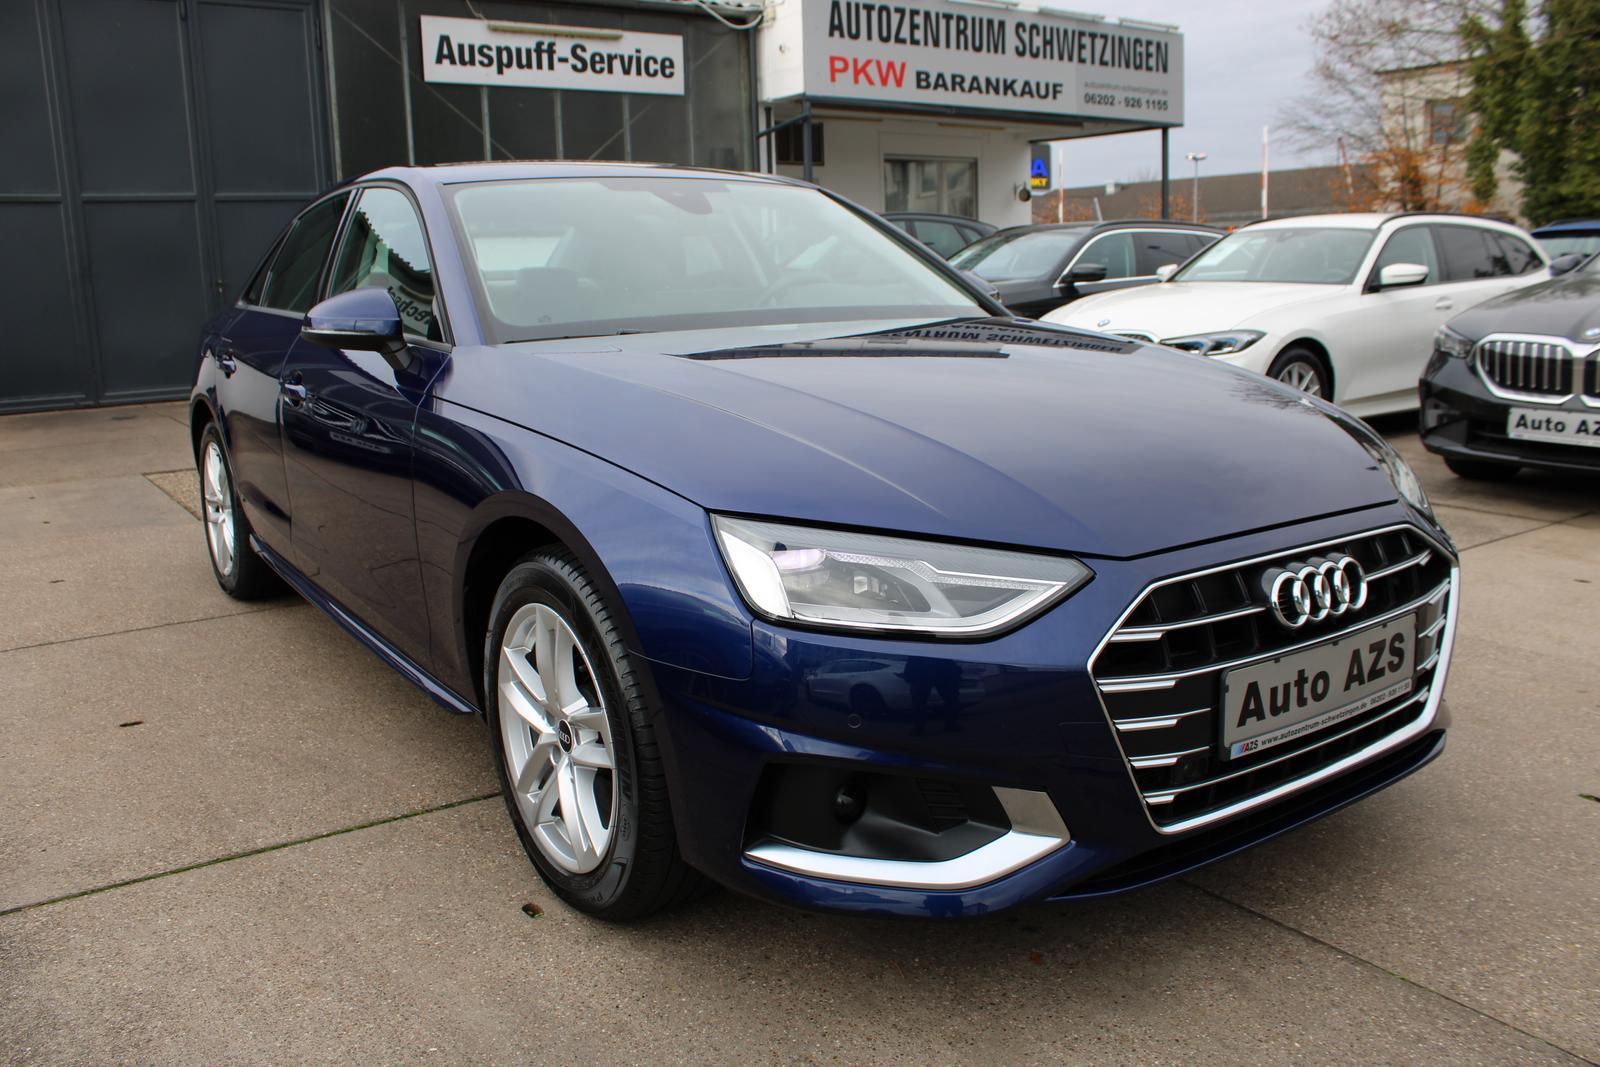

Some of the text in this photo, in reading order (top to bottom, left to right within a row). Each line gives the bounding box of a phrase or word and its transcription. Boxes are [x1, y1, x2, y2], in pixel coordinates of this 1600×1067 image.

[435, 34, 675, 79] Auspuff-Service
[828, 0, 1169, 74] AUTOZENTRUM SCHWETZINGEN
[828, 55, 1063, 101] PKW BARANKAUF
[1084, 92, 1116, 107] 06202
[1124, 96, 1143, 109] 926
[1145, 99, 1169, 111] 1155
[1516, 414, 1566, 433] Auto
[1236, 632, 1405, 728] Auto AZS
